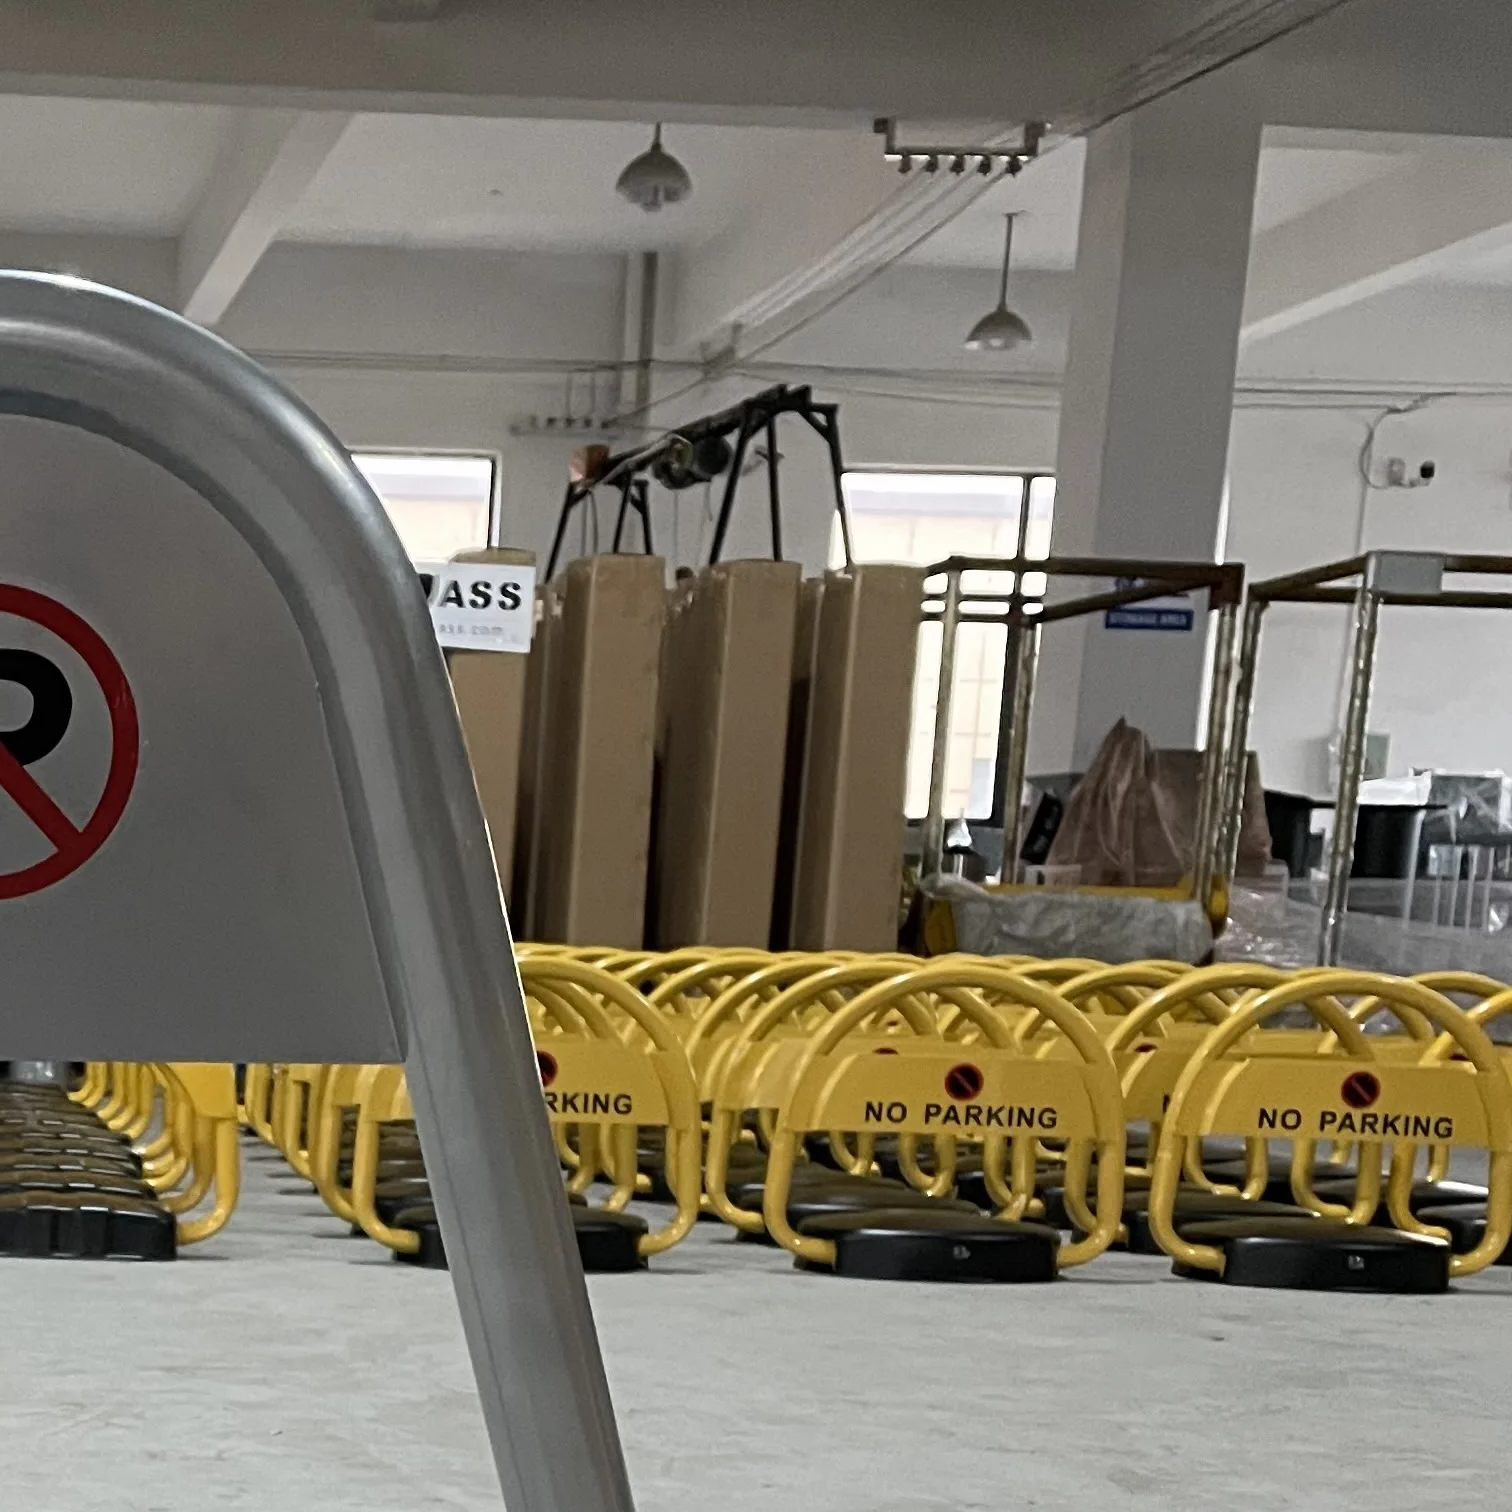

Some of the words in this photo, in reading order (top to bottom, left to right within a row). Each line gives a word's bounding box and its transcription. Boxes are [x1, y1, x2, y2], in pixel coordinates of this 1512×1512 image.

[865, 1101, 908, 1124] NO
[924, 1103, 1058, 1129] PARKING
[1258, 1107, 1302, 1131] NO
[1319, 1110, 1454, 1139] PARKING
